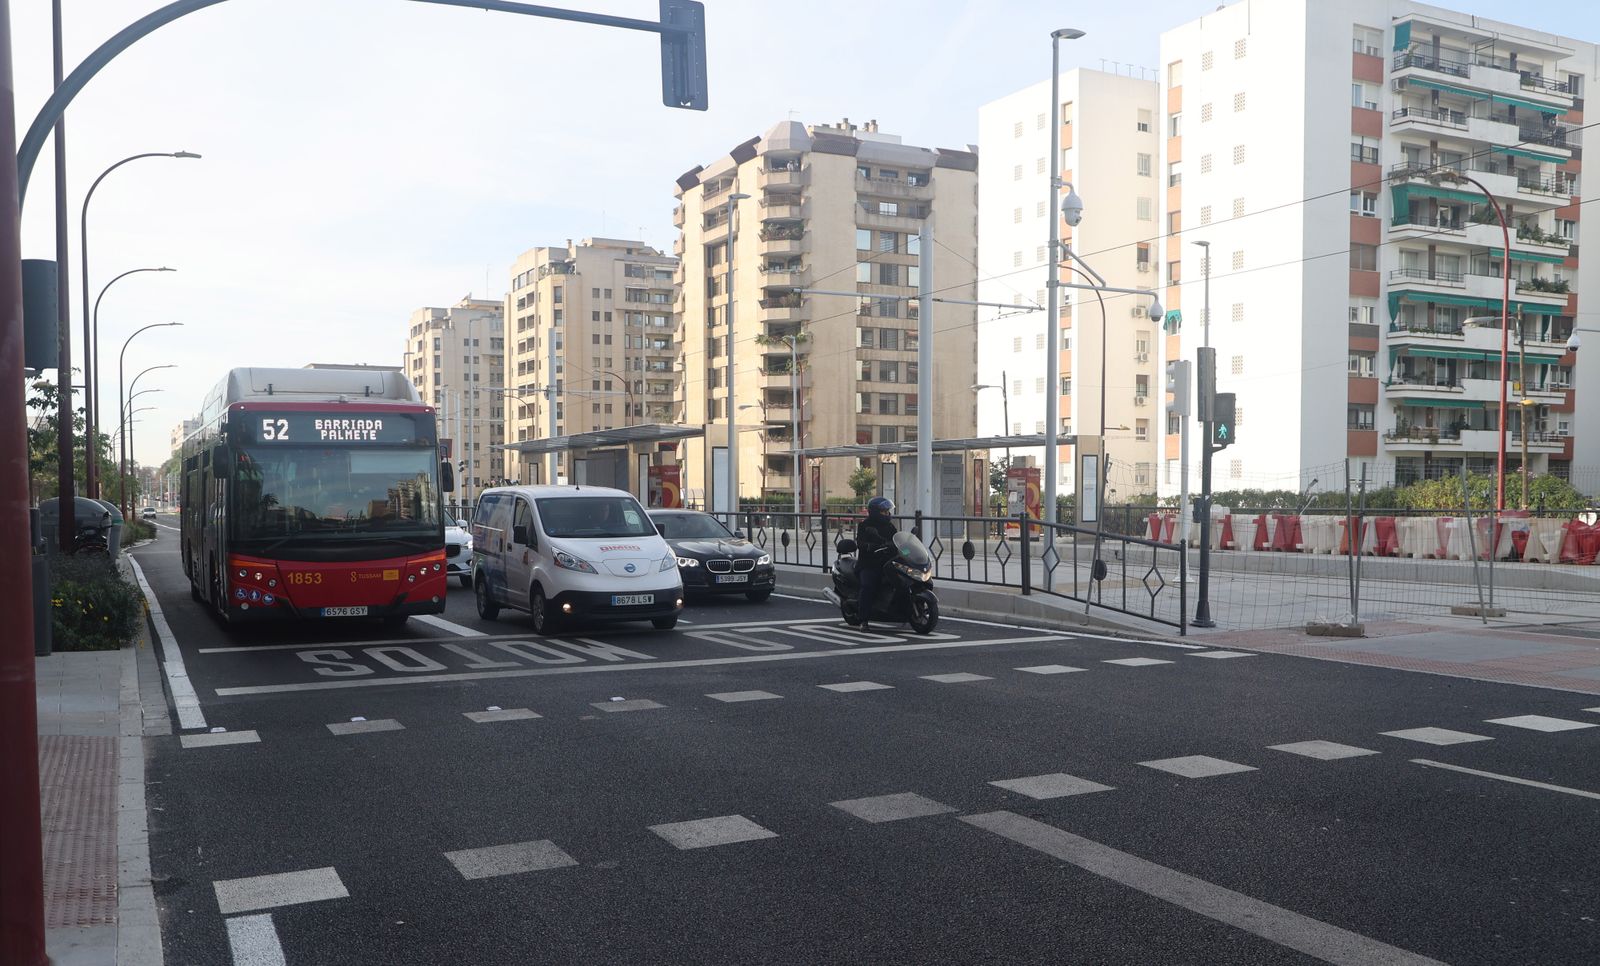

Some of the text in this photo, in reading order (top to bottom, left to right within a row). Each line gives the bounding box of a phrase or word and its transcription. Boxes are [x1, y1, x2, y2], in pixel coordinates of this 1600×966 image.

[262, 419, 289, 440] 52
[315, 419, 383, 430] BARRIADA
[321, 430, 377, 440] PALMETE
[287, 572, 322, 584] 1853
[616, 596, 636, 605] 8678
[326, 606, 366, 616] 6576 GSY
[296, 638, 658, 677] MOTOS
